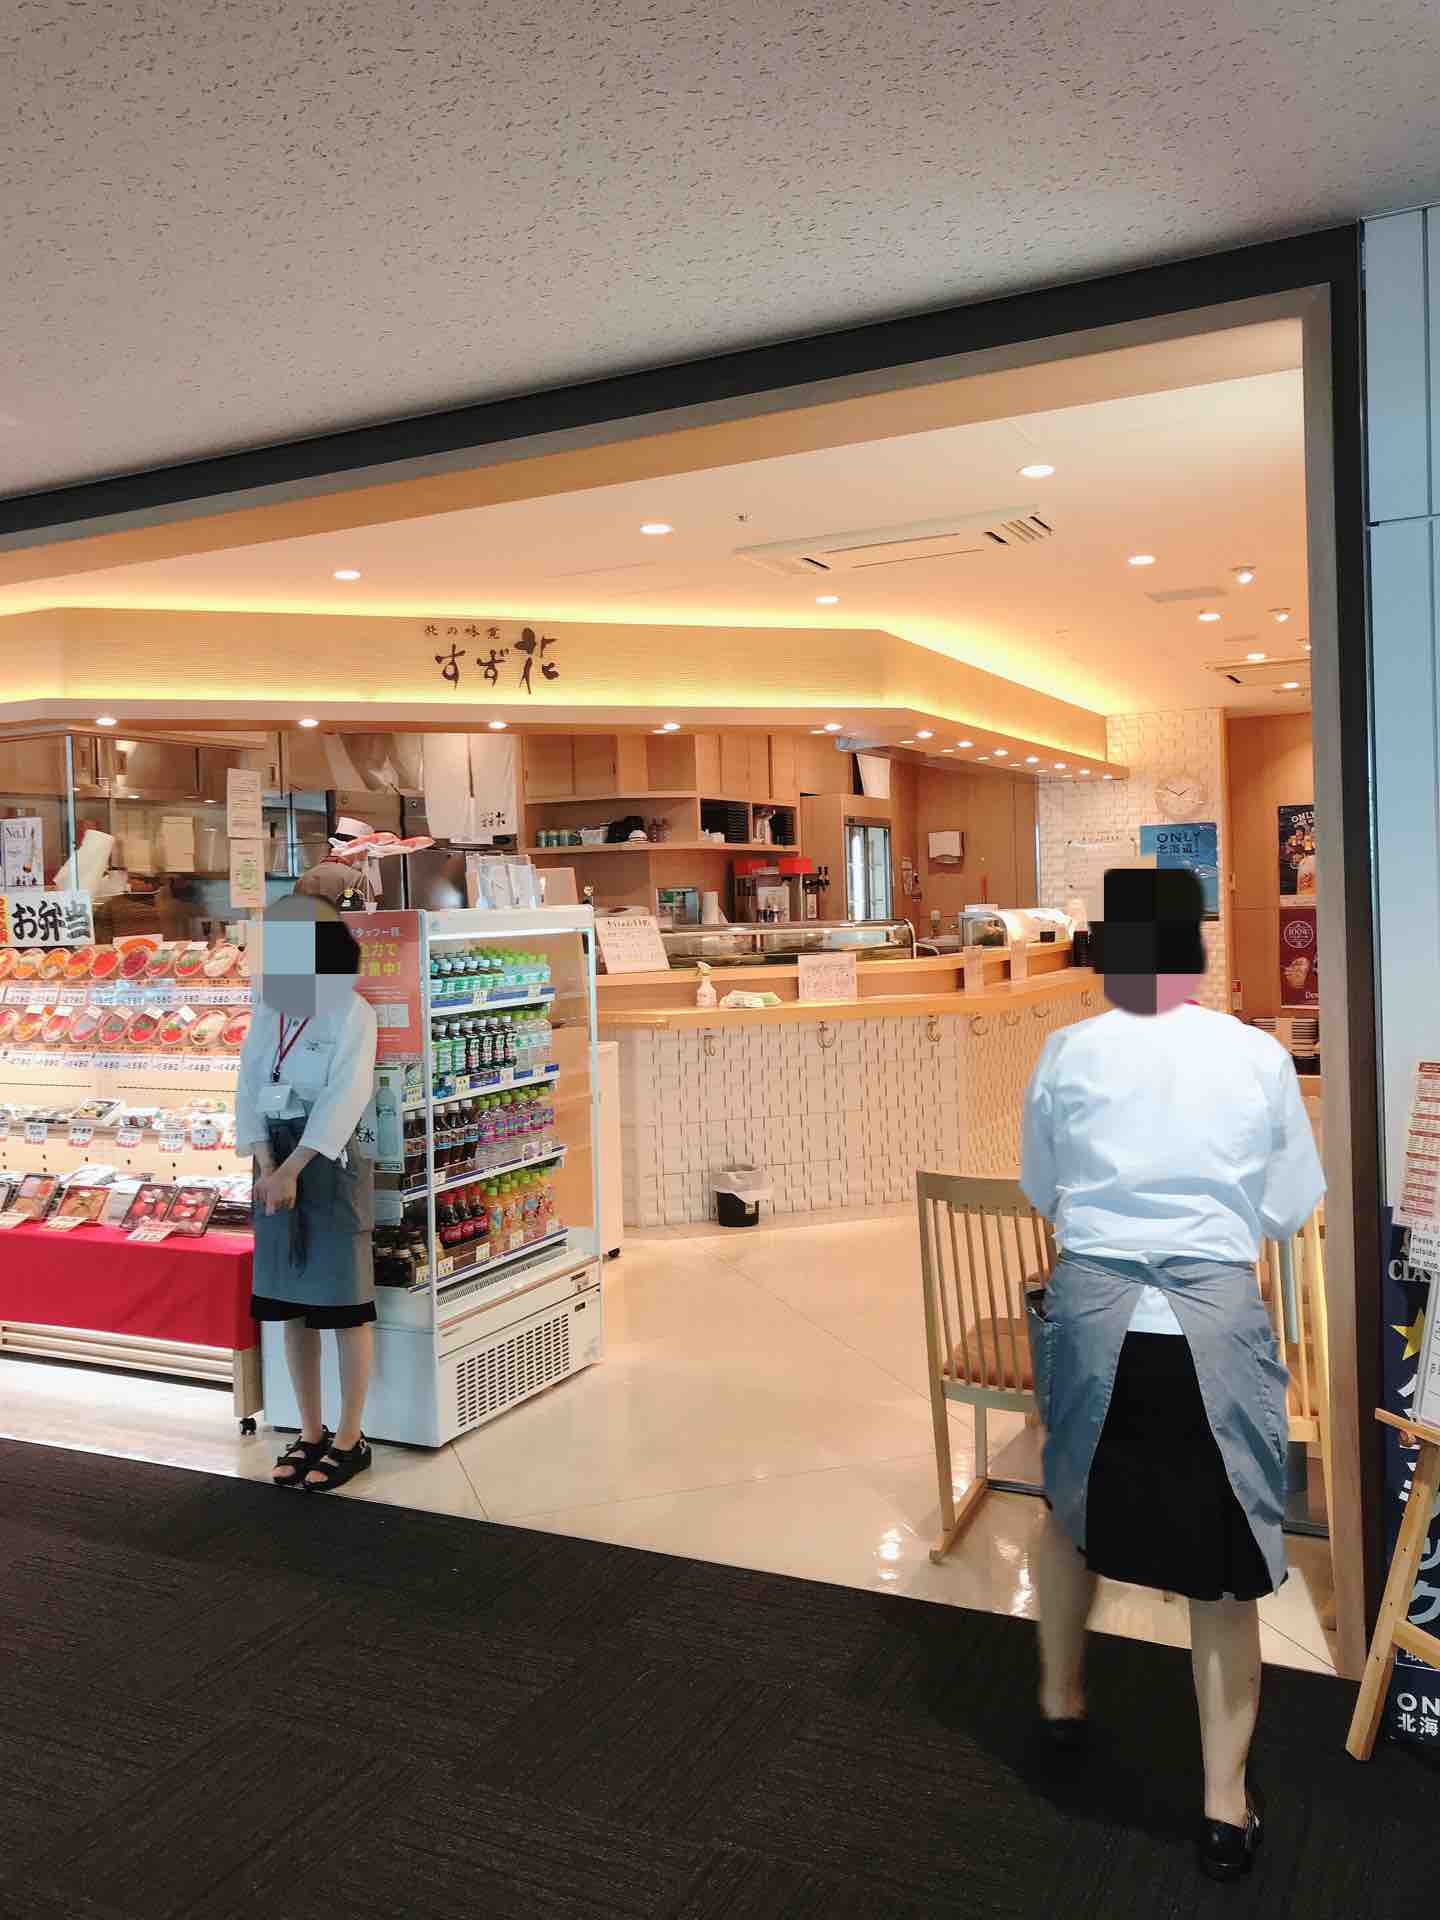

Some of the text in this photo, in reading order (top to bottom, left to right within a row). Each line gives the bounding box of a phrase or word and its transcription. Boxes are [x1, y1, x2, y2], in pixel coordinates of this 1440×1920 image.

[435, 628, 560, 695] すず花
[1157, 831, 1200, 843] ONLY
[11, 900, 90, 941] お弁当
[1397, 1712, 1439, 1736] 北海
